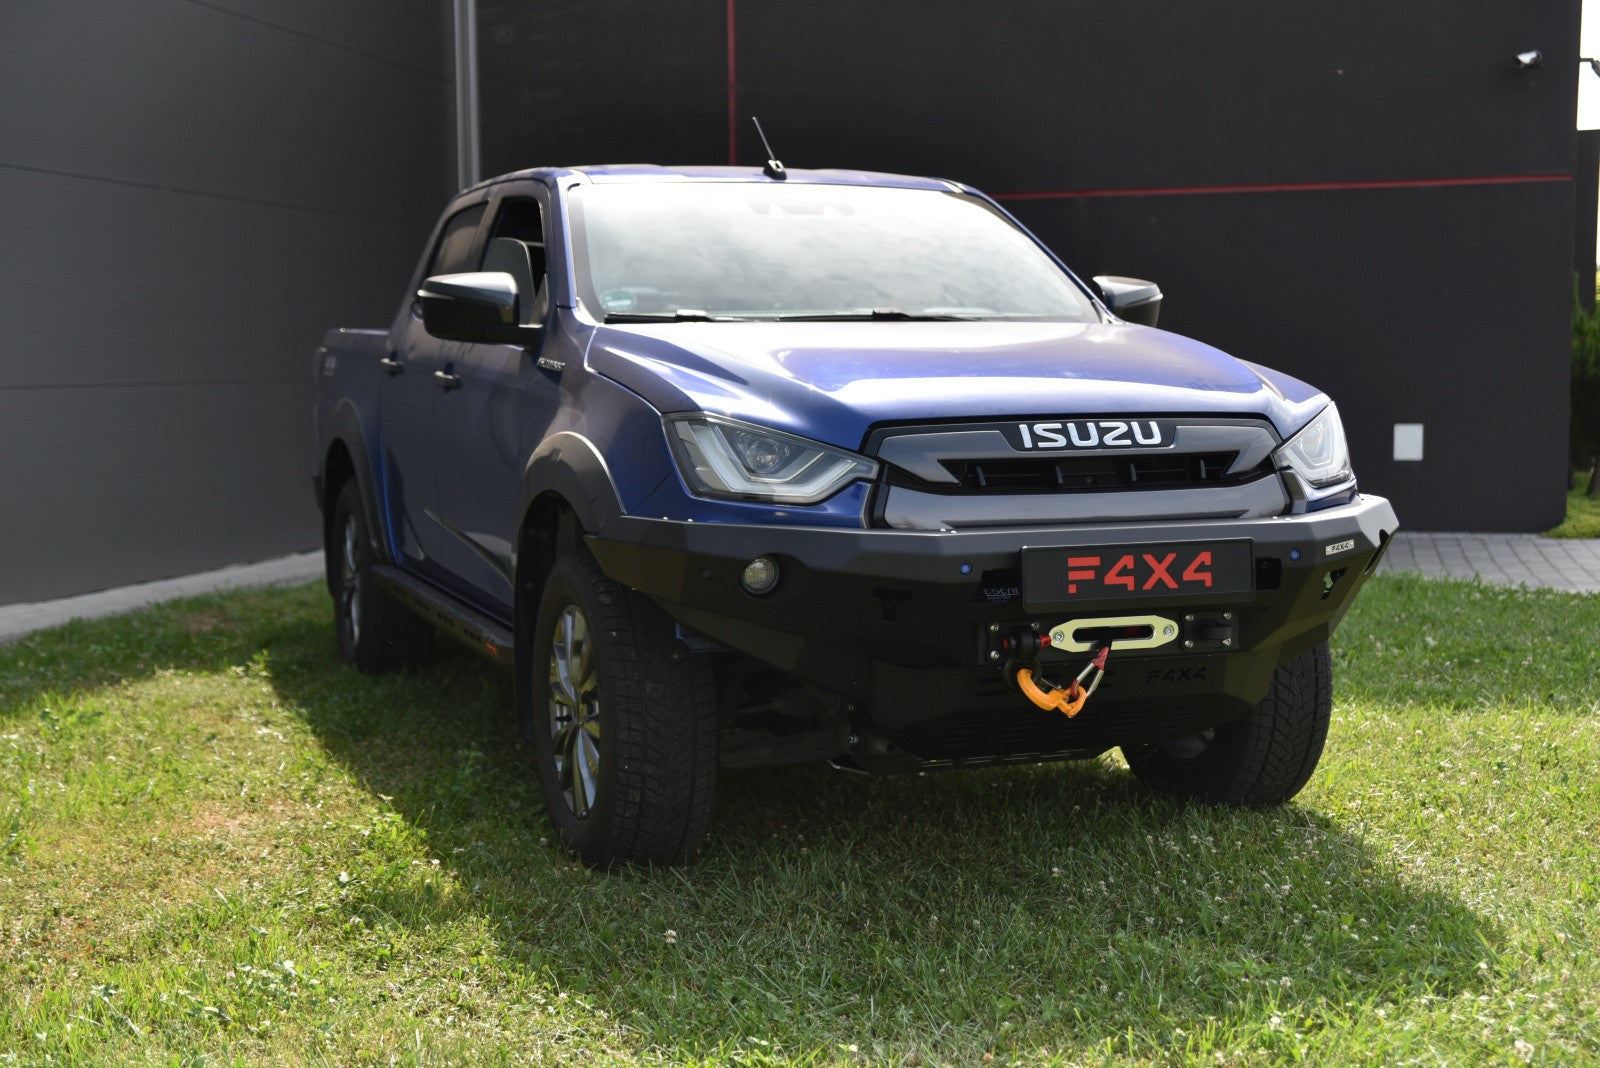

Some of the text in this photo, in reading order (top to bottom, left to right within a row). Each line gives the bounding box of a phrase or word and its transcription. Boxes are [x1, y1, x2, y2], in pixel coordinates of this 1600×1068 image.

[1019, 421, 1162, 448] ISUZU
[1331, 542, 1349, 553] F4X4
[1067, 551, 1212, 594] F4X4
[1146, 666, 1207, 687] F4X4
